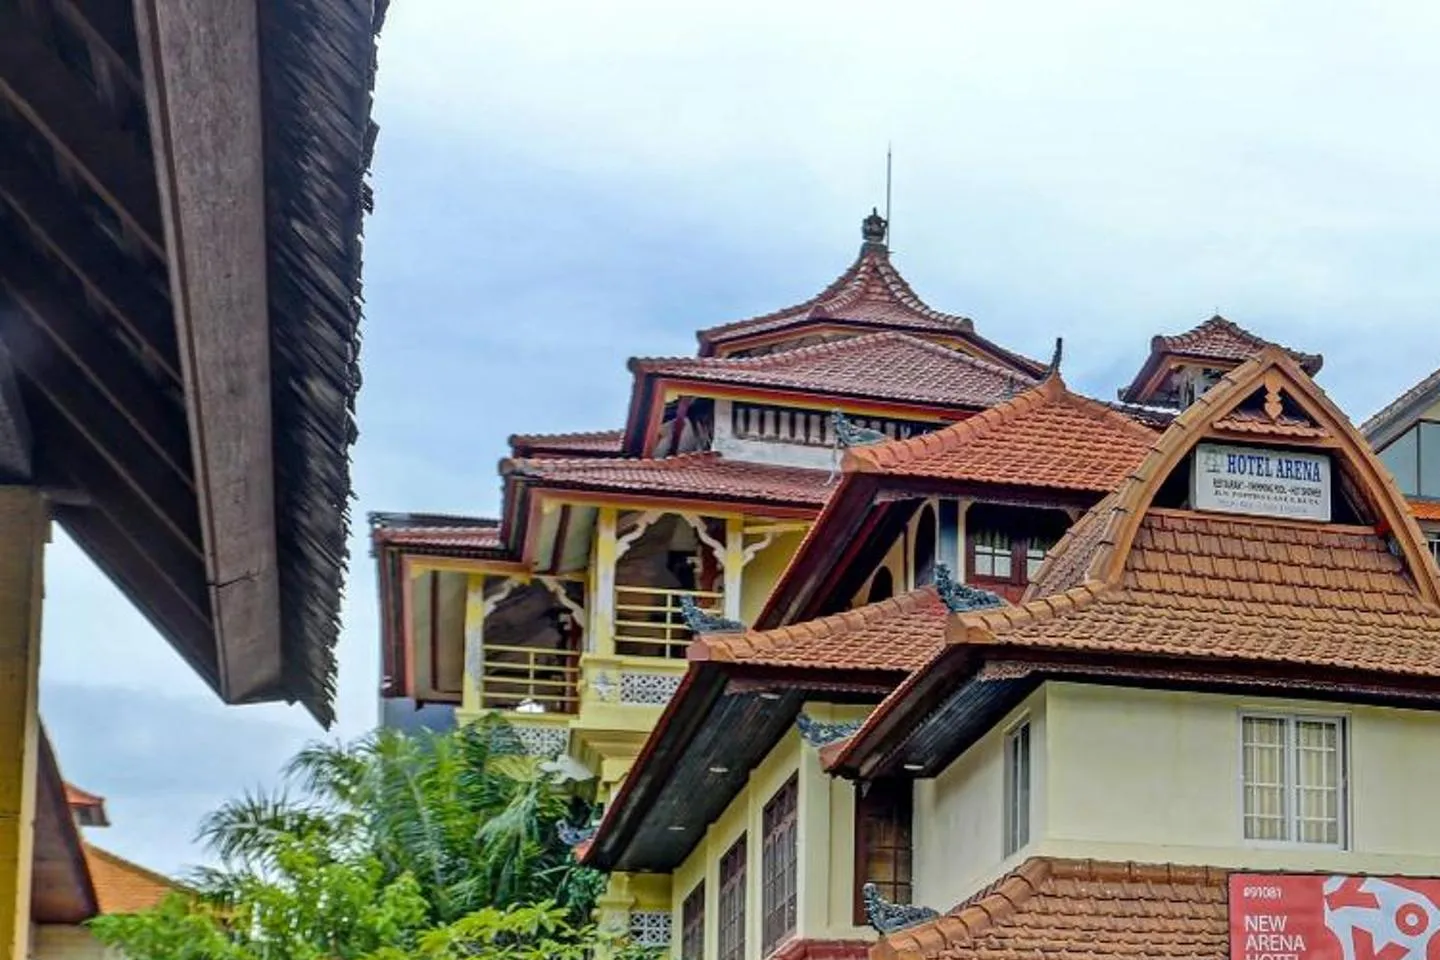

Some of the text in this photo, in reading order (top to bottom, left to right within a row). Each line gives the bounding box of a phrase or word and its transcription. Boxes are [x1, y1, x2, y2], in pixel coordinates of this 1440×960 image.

[1227, 454, 1321, 482] HOTEL ARENA
[1244, 915, 1288, 933] NEW
[1244, 934, 1307, 952] ARENA
